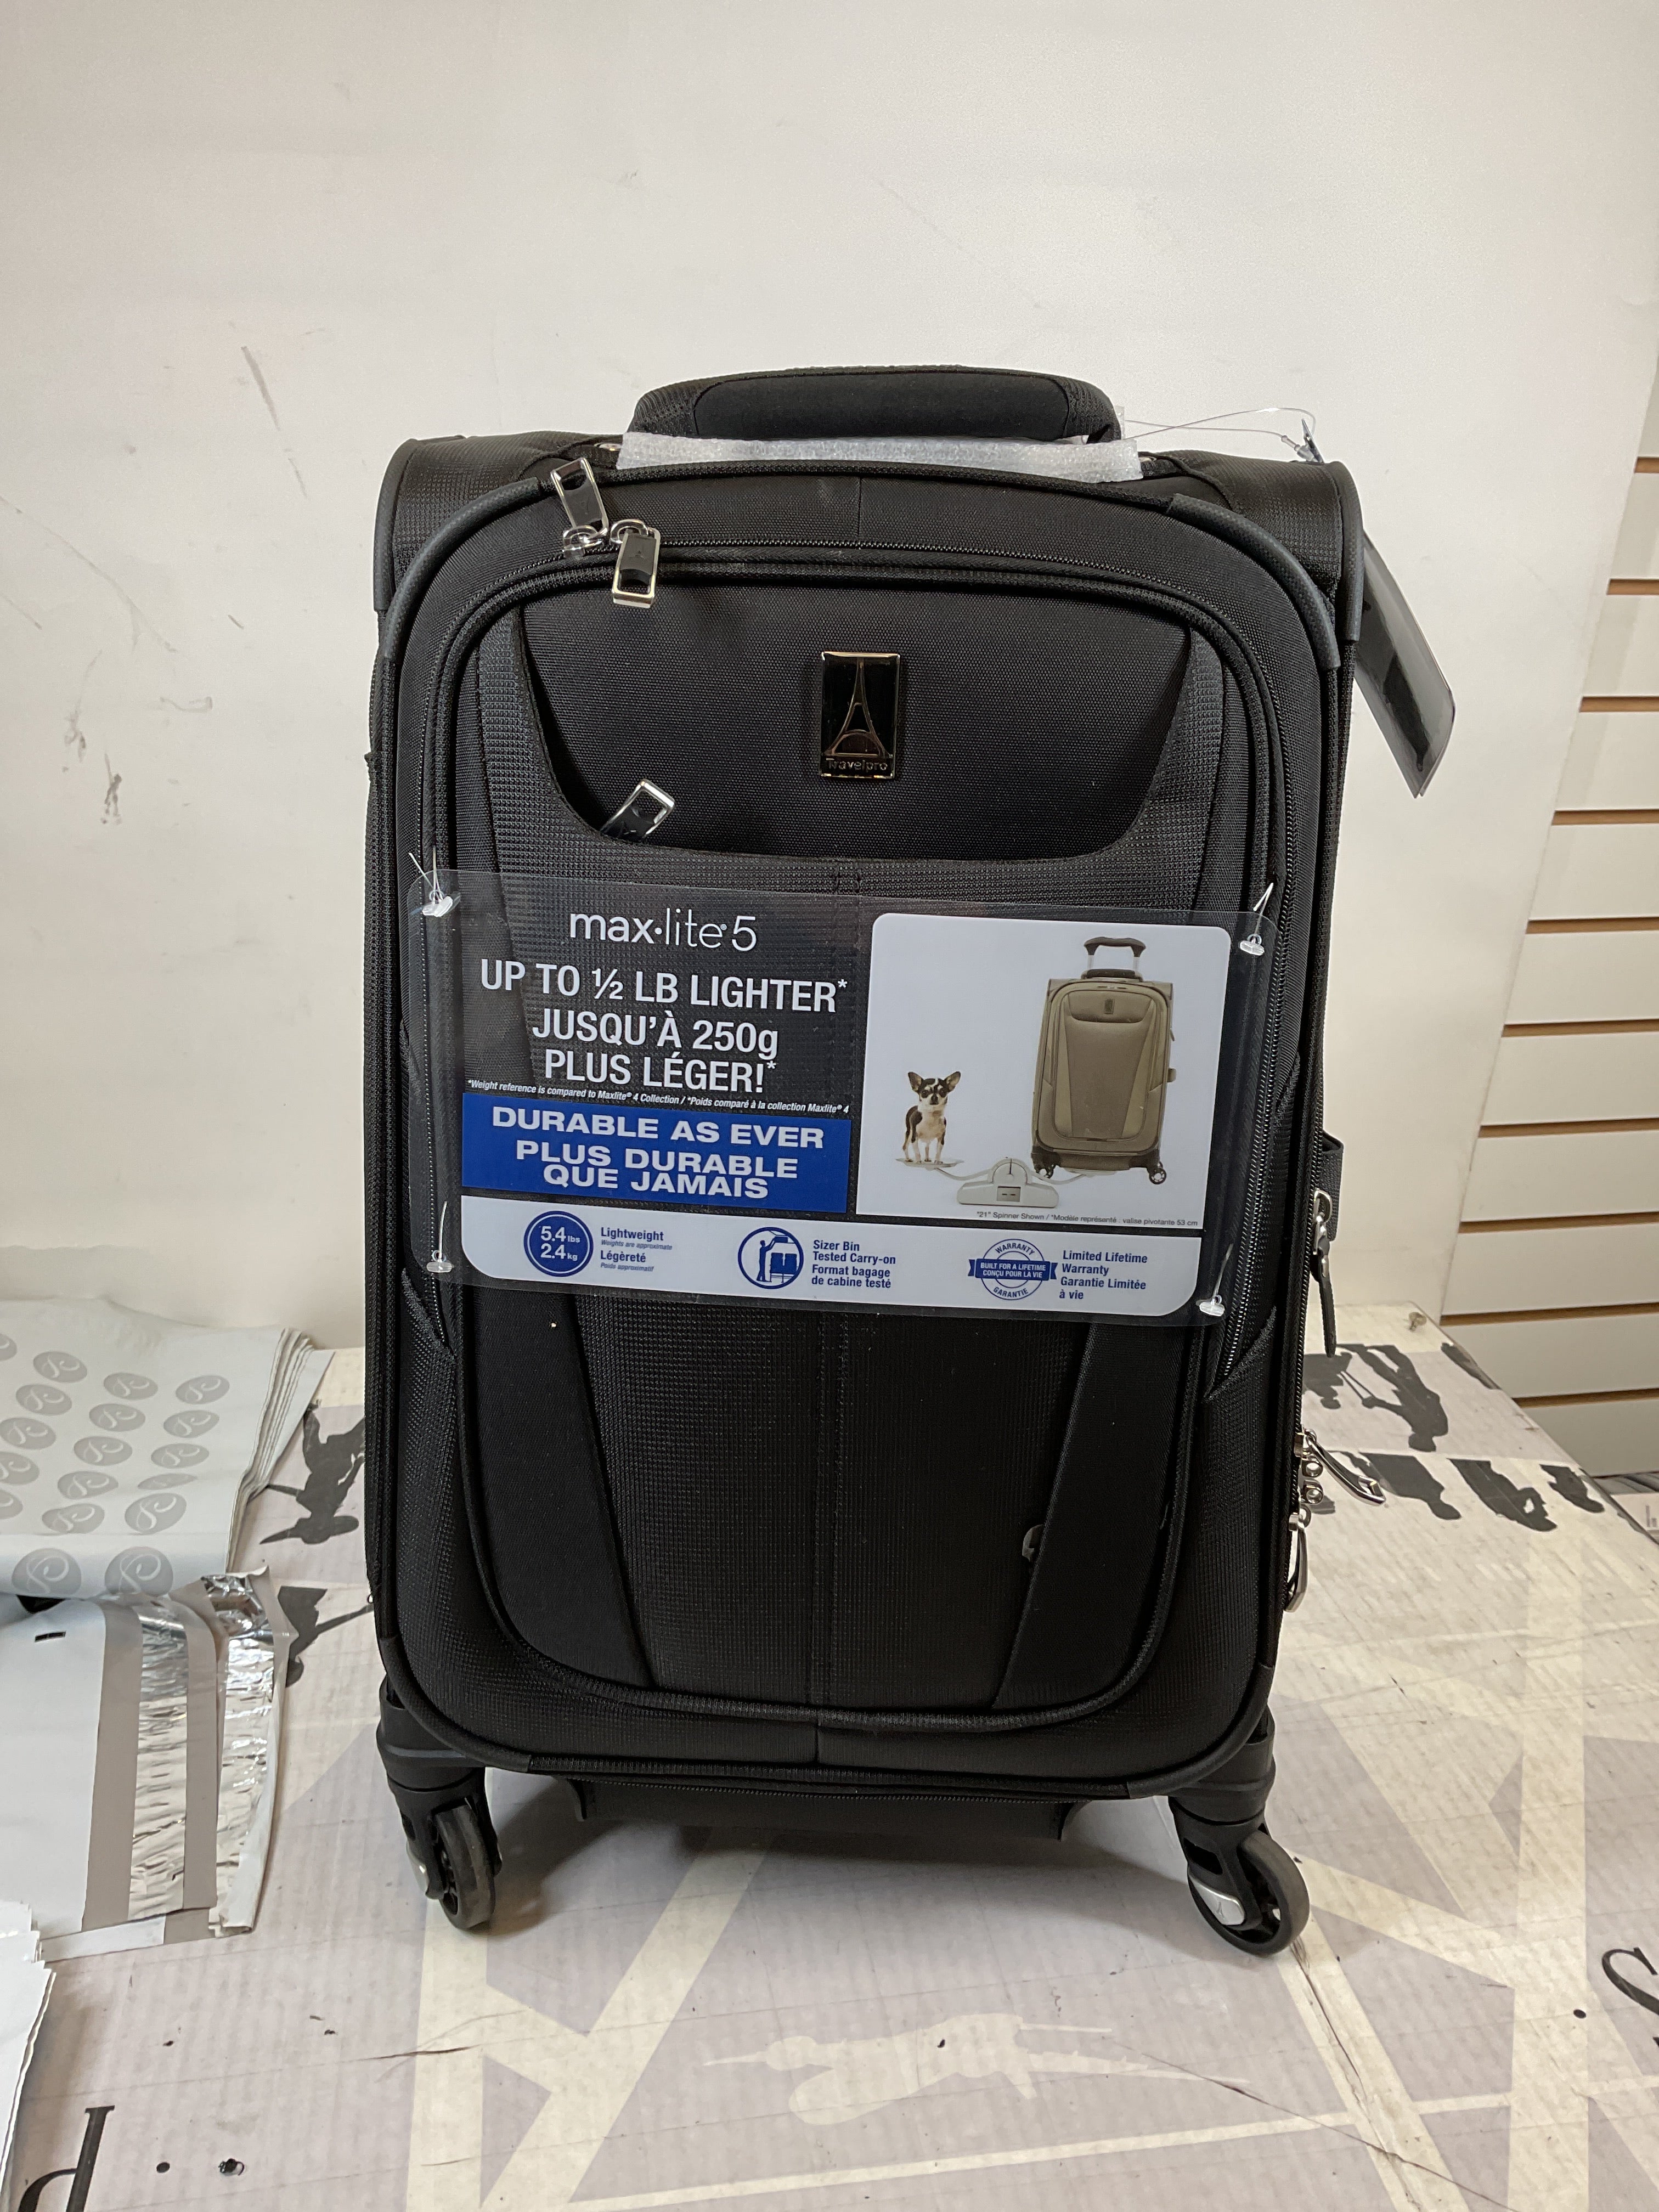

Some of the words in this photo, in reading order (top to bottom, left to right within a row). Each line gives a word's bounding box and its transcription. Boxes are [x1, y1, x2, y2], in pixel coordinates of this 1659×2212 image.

[481, 958, 526, 990] UP
[535, 963, 580, 996] TO
[635, 970, 679, 1003] LB
[693, 1019, 778, 1060] 250g
[545, 1049, 631, 1085] PLUS
[499, 1084, 536, 1094] reference
[538, 1086, 546, 1094] is
[547, 1087, 586, 1099] compared
[588, 1089, 596, 1098] to
[640, 1093, 679, 1104] Collection
[714, 1099, 749, 1109] comparé
[751, 1100, 757, 1109] à
[768, 1103, 806, 1111] collection
[843, 1105, 850, 1114] 4
[493, 1106, 658, 1139] DURABLE
[670, 1121, 719, 1143] AS
[731, 1124, 825, 1148] EVER
[516, 1140, 612, 1166] PLUS
[624, 1148, 798, 1179] DURABLE
[543, 1165, 618, 1189] QUE
[630, 1172, 769, 1198] JAMAIS
[601, 1227, 664, 1241] Lightweight
[813, 1240, 840, 1251] Sizer
[843, 1242, 860, 1251] Bin
[995, 1243, 1035, 1255] WARRANTY
[601, 1250, 646, 1263] Légèreté
[812, 1250, 847, 1262] Tested
[850, 1253, 896, 1265] Carry-on
[1063, 1250, 1102, 1261] Limited
[1105, 1252, 1148, 1263] Lifetime
[812, 1264, 849, 1276] Format
[852, 1266, 891, 1279] bagage
[1062, 1263, 1109, 1277] Warranty
[811, 1275, 825, 1285] de
[827, 1277, 862, 1287] cabine
[865, 1278, 891, 1289] testé
[1060, 1276, 1104, 1288] Garantie
[1108, 1278, 1146, 1290] Limitée
[993, 1286, 1029, 1298] GARANTIE
[1059, 1289, 1065, 1299] à
[1069, 1290, 1084, 1300] vie
